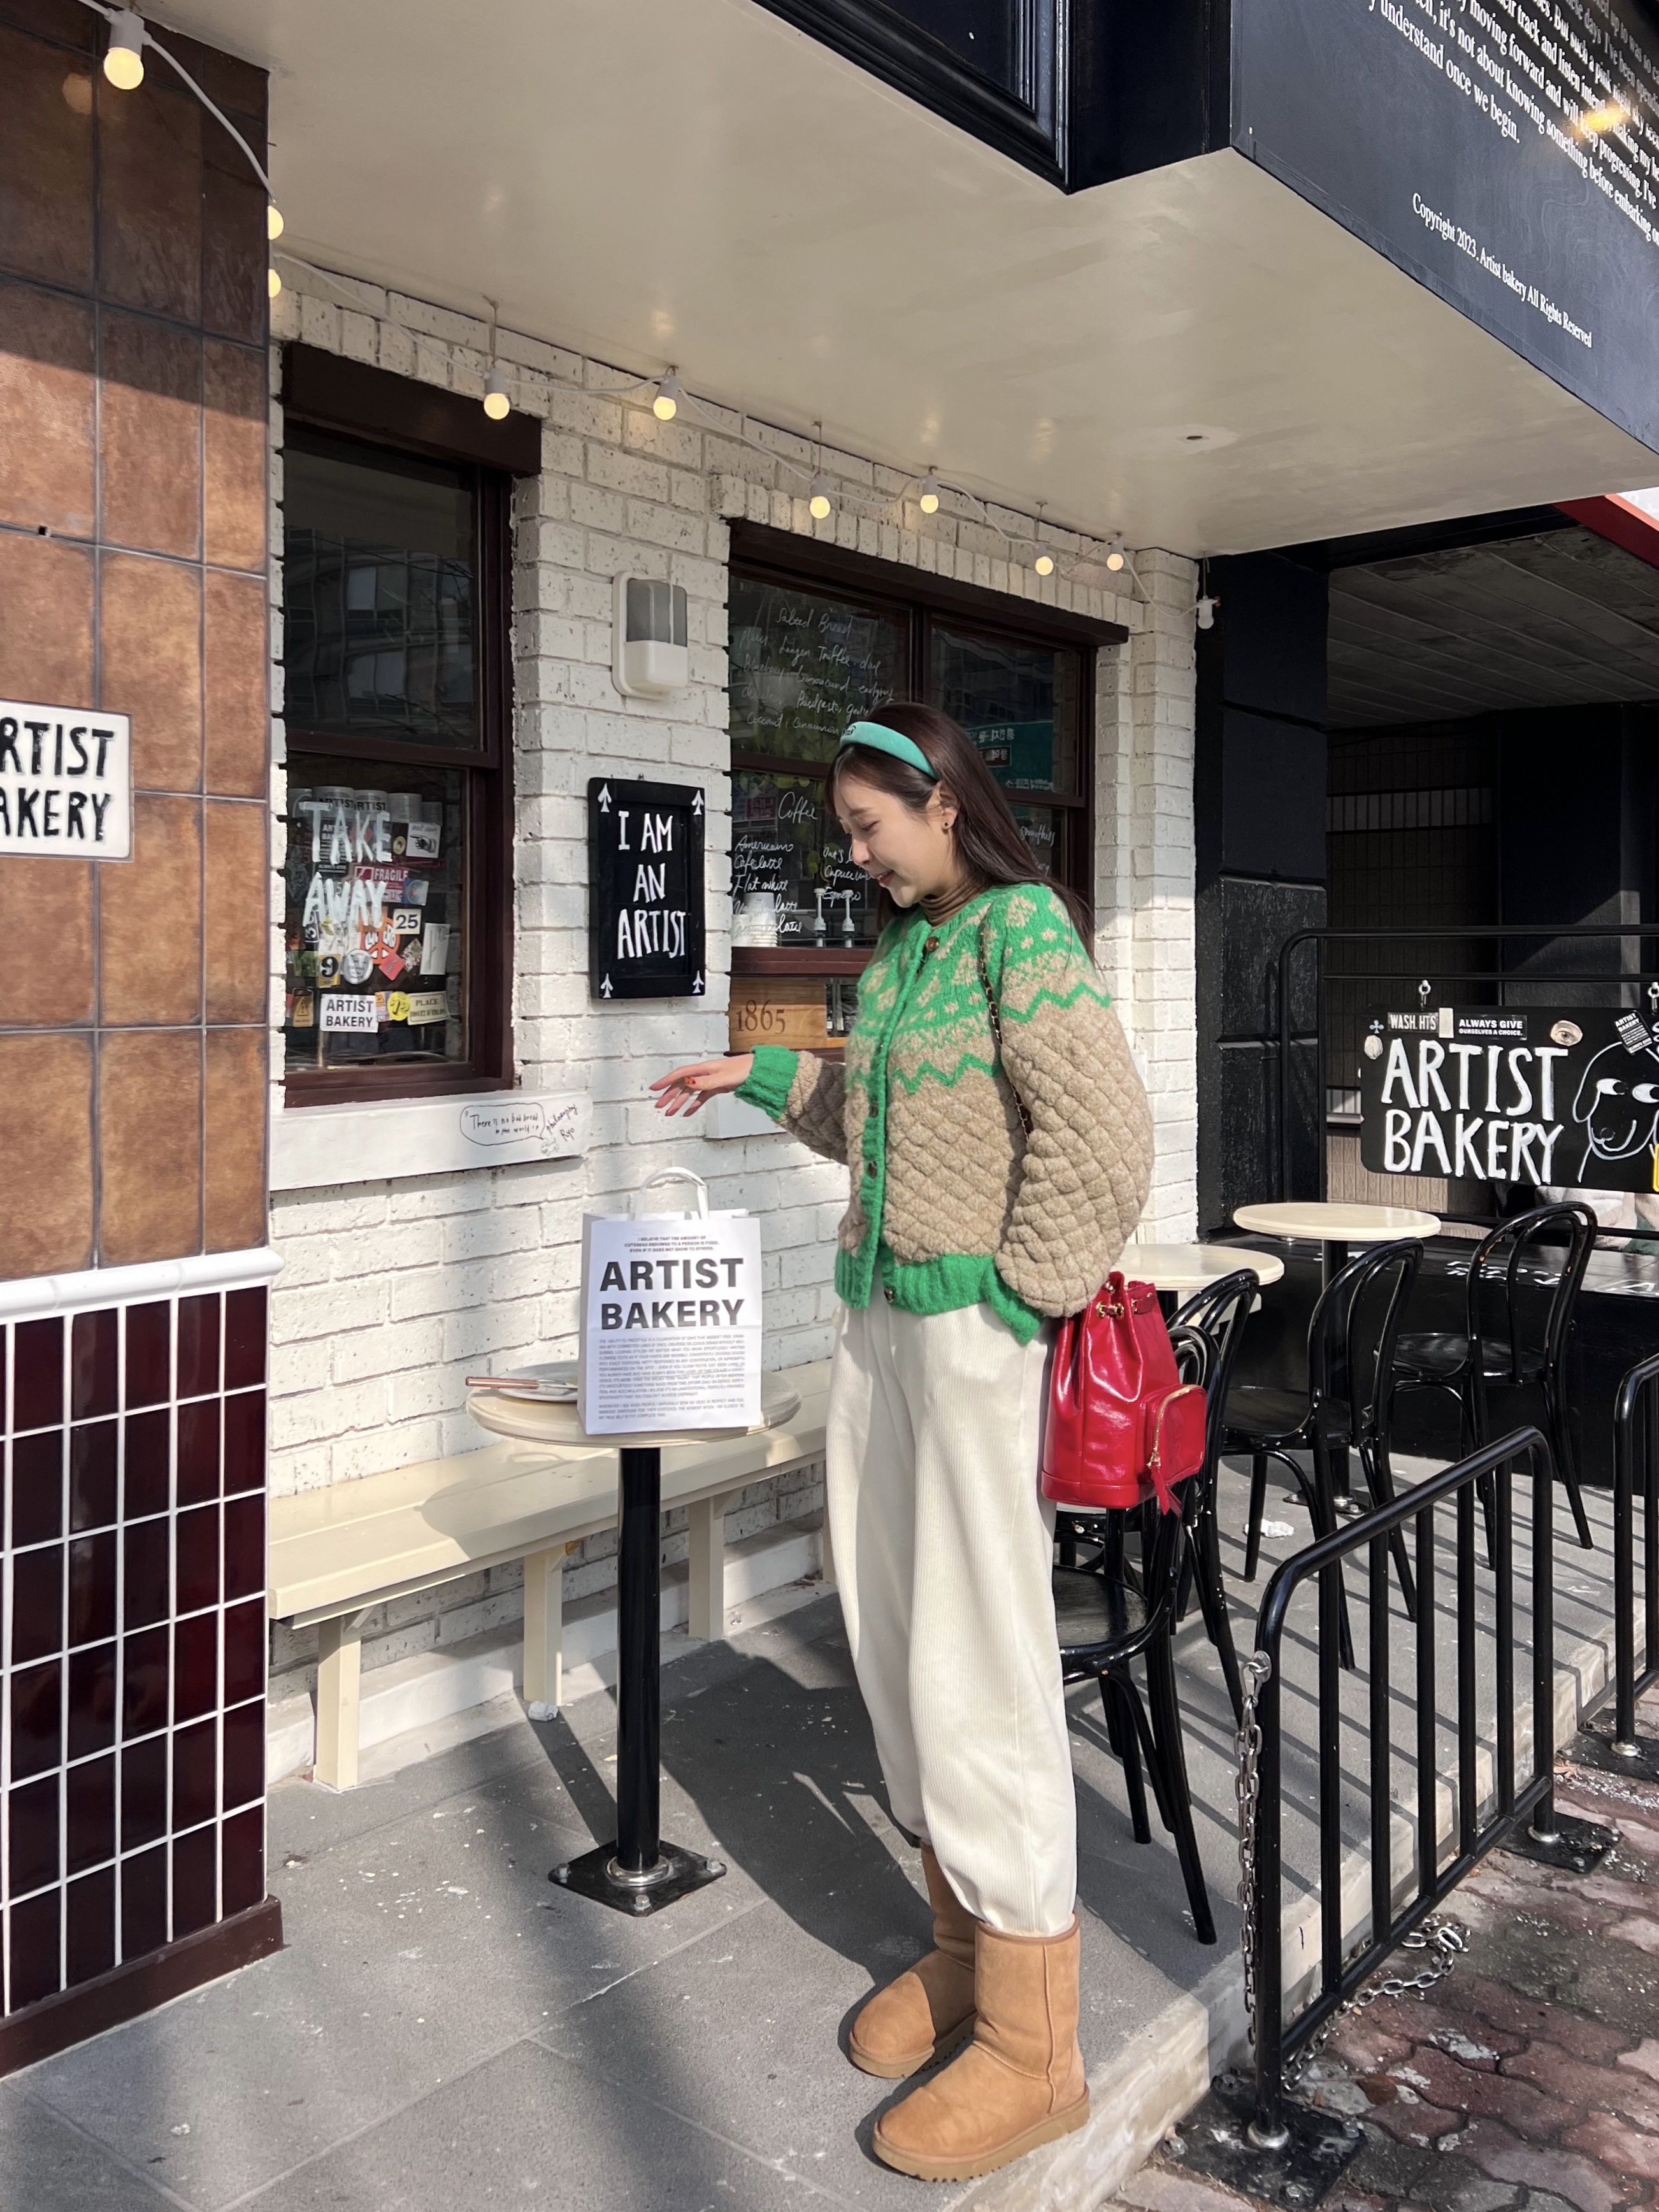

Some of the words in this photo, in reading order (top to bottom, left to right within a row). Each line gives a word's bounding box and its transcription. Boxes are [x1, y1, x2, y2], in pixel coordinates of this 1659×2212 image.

[1554, 4, 1569, 41] But
[1570, 31, 1588, 64] such
[1589, 55, 1595, 72] a
[1595, 61, 1612, 94] pink
[1632, 105, 1645, 136] sky
[1584, 8, 1602, 44] days
[1619, 51, 1635, 87] been
[1380, 0, 1444, 70] understand
[1446, 59, 1472, 96] once
[1474, 83, 1489, 112] we
[1490, 94, 1520, 144] begin.
[1517, 3, 1541, 47] track
[1541, 36, 1557, 66] and
[1558, 48, 1581, 92] listen
[1640, 149, 1651, 176] my
[1439, 1, 1456, 38] it's
[1458, 27, 1476, 58] not
[1476, 44, 1505, 88] about
[1505, 69, 1545, 134] knowing
[1546, 118, 1588, 179] something
[1589, 157, 1614, 199] before
[1614, 189, 1652, 242] embarking
[1470, 0, 1507, 55] moving
[1508, 33, 1544, 90] forward
[1546, 80, 1562, 108] and
[1562, 97, 1579, 128] will
[1598, 138, 1643, 199] progressing.
[1644, 178, 1657, 210] I've
[1412, 192, 1456, 241] Copyright
[1479, 247, 1502, 279] Artist
[1502, 263, 1527, 303] bakery
[1526, 285, 1539, 308] All
[1539, 294, 1562, 324] Rights
[1562, 311, 1592, 348] Reserved
[0, 717, 115, 777] RTIST
[779, 791, 818, 824] Coffee
[299, 801, 394, 865] TAKE
[619, 810, 630, 851] I
[641, 812, 673, 854] AM
[302, 872, 387, 929] AWAY
[633, 863, 666, 903] AN
[396, 915, 419, 929] 25
[617, 908, 686, 959] ARTIST
[320, 956, 339, 979] 9
[326, 1000, 373, 1013] ARTIST
[326, 1016, 373, 1028] BAKERY
[415, 998, 440, 1007] PLACE
[736, 999, 786, 1035] 1865
[1390, 1014, 1418, 1030] WASH.
[1419, 1015, 1437, 1031] HTS
[1458, 1019, 1498, 1029] ALWAYS
[1499, 1020, 1523, 1030] GIVE
[1381, 1038, 1569, 1122] ARTIST
[1384, 1109, 1565, 1186] BAKERY
[600, 1258, 743, 1291] ARTIST
[601, 1299, 745, 1330] BAKERY
